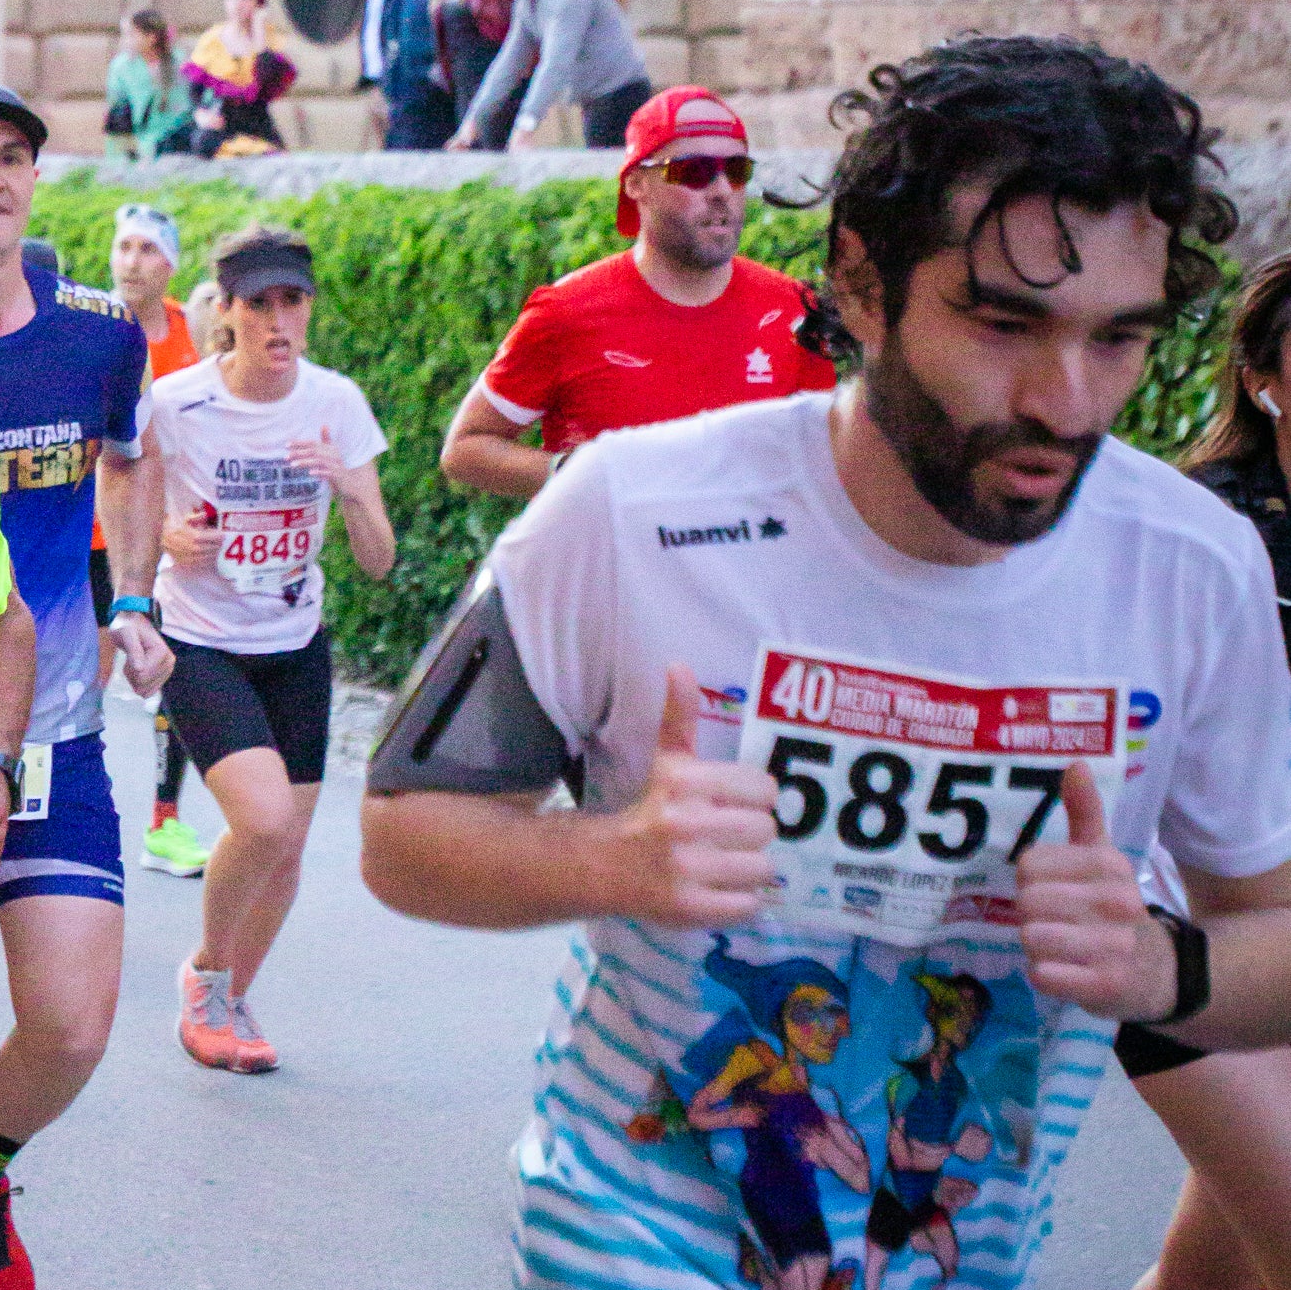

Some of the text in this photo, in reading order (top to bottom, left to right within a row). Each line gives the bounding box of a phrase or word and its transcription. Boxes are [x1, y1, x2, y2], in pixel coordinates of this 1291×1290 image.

[216, 459, 241, 483] 40
[224, 529, 311, 566] 4849
[658, 519, 752, 550] luanvi
[770, 660, 836, 723] 40
[766, 735, 1066, 865] 5857
